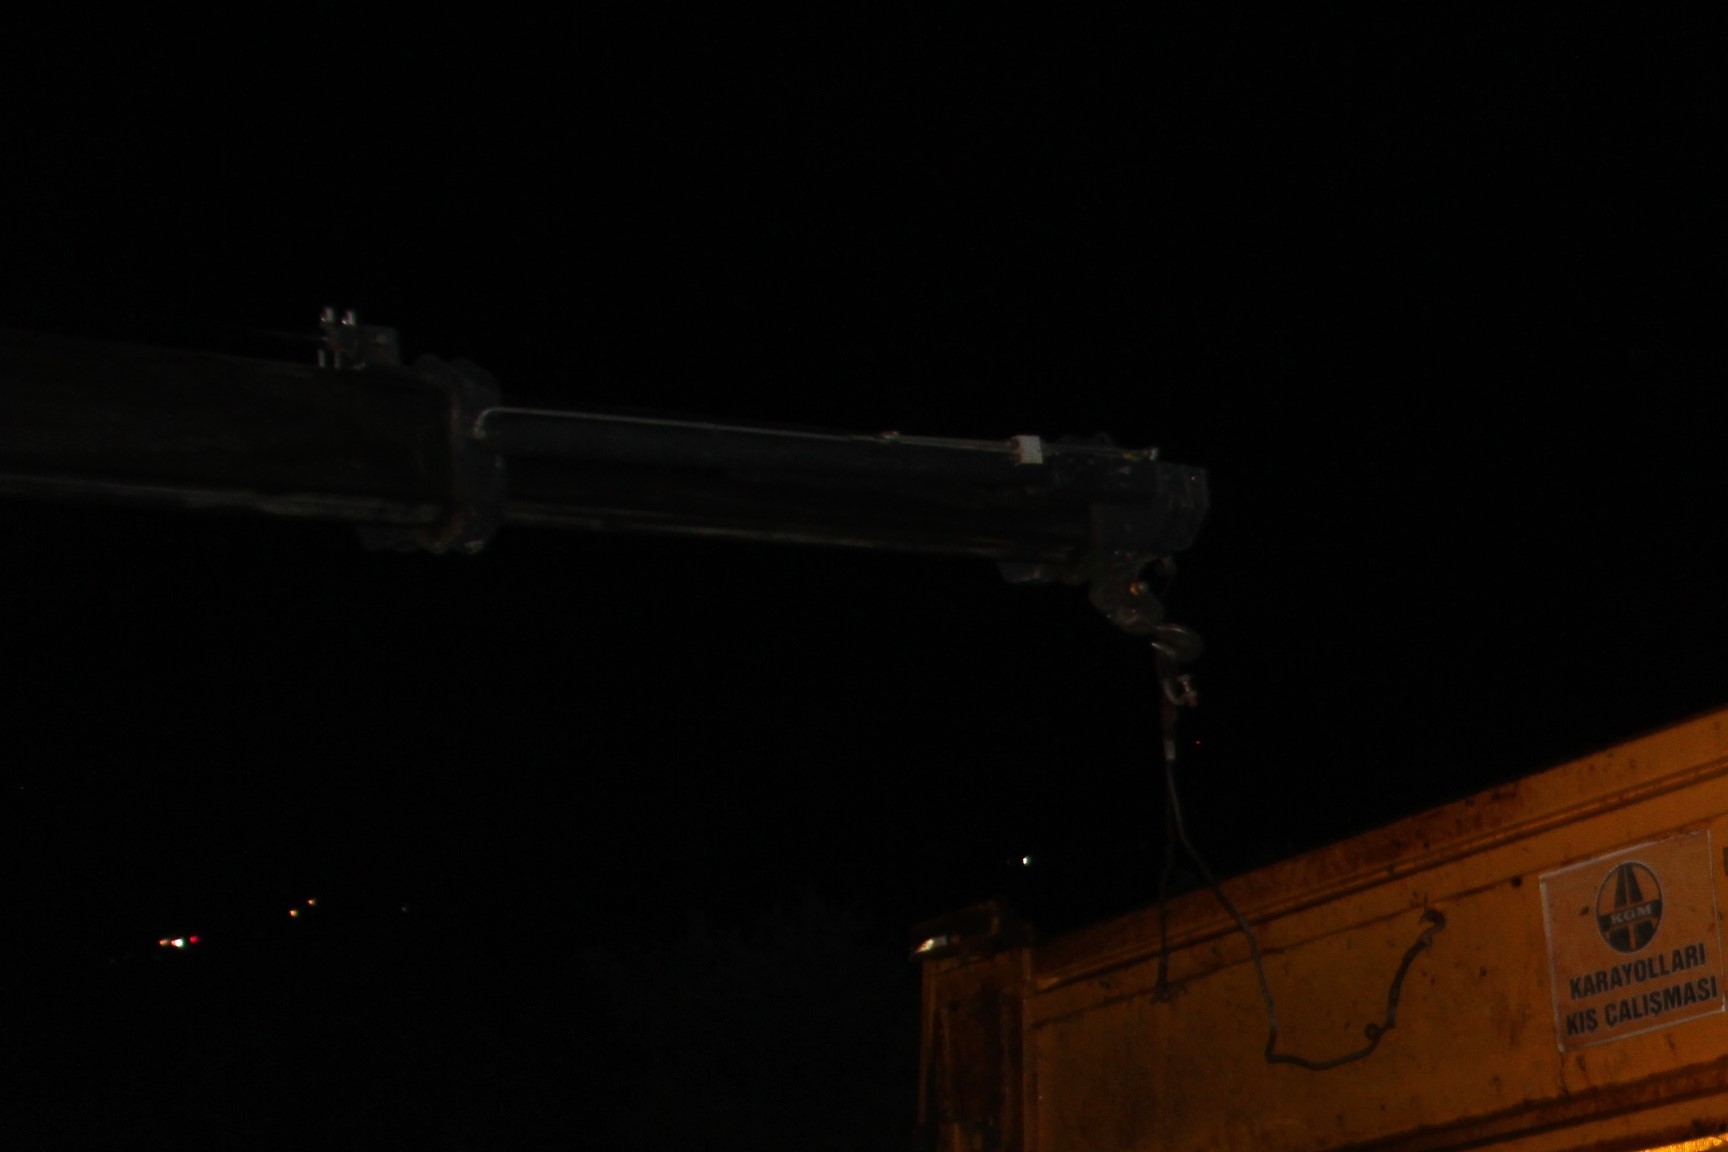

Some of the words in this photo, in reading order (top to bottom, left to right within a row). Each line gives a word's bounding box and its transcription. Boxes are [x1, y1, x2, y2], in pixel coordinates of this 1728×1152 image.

[1610, 903, 1652, 924] KGM
[1569, 943, 1706, 1000] KARAYOLLARI
[1566, 1007, 1599, 1036] KIŞ
[1604, 975, 1718, 1028] ÇALIŞMASI
